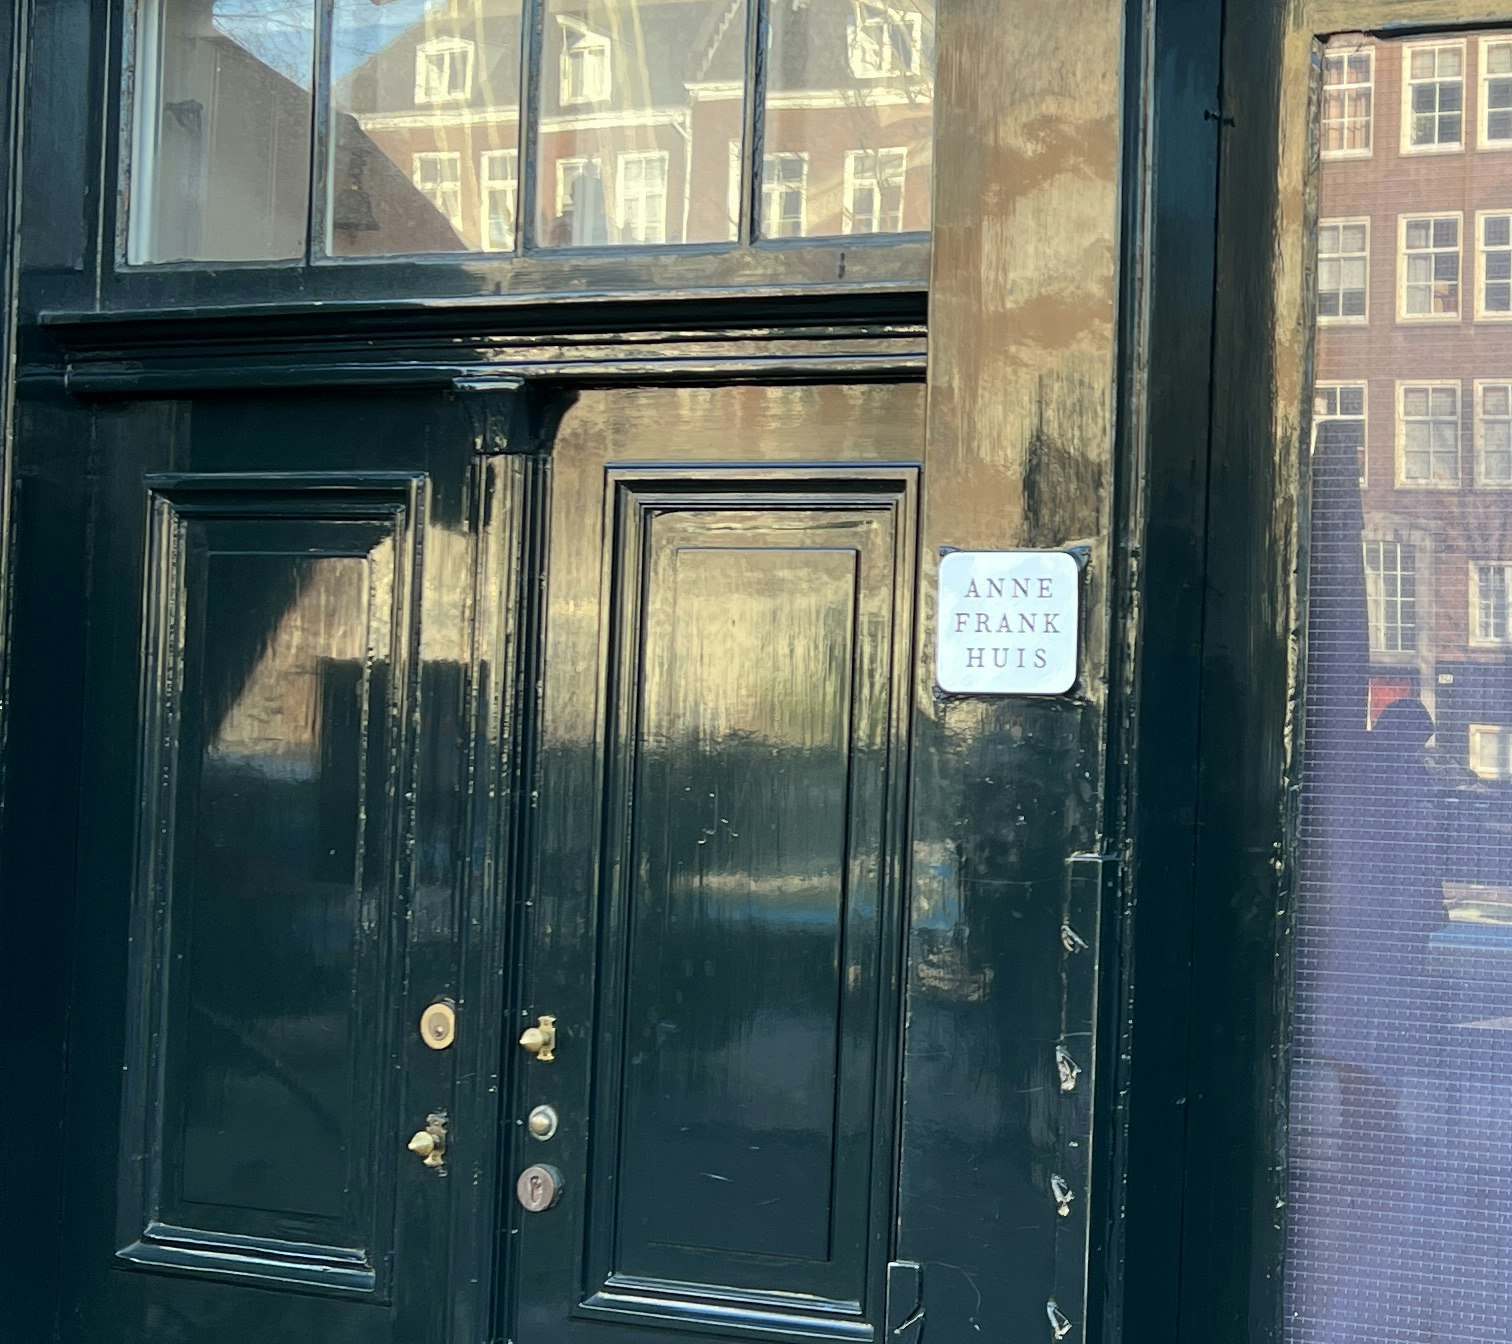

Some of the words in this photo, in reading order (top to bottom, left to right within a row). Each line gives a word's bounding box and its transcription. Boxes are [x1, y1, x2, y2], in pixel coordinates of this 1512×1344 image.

[964, 577, 1053, 598] ANNE
[955, 612, 1061, 633] FRANK
[966, 647, 1047, 668] HUIS
